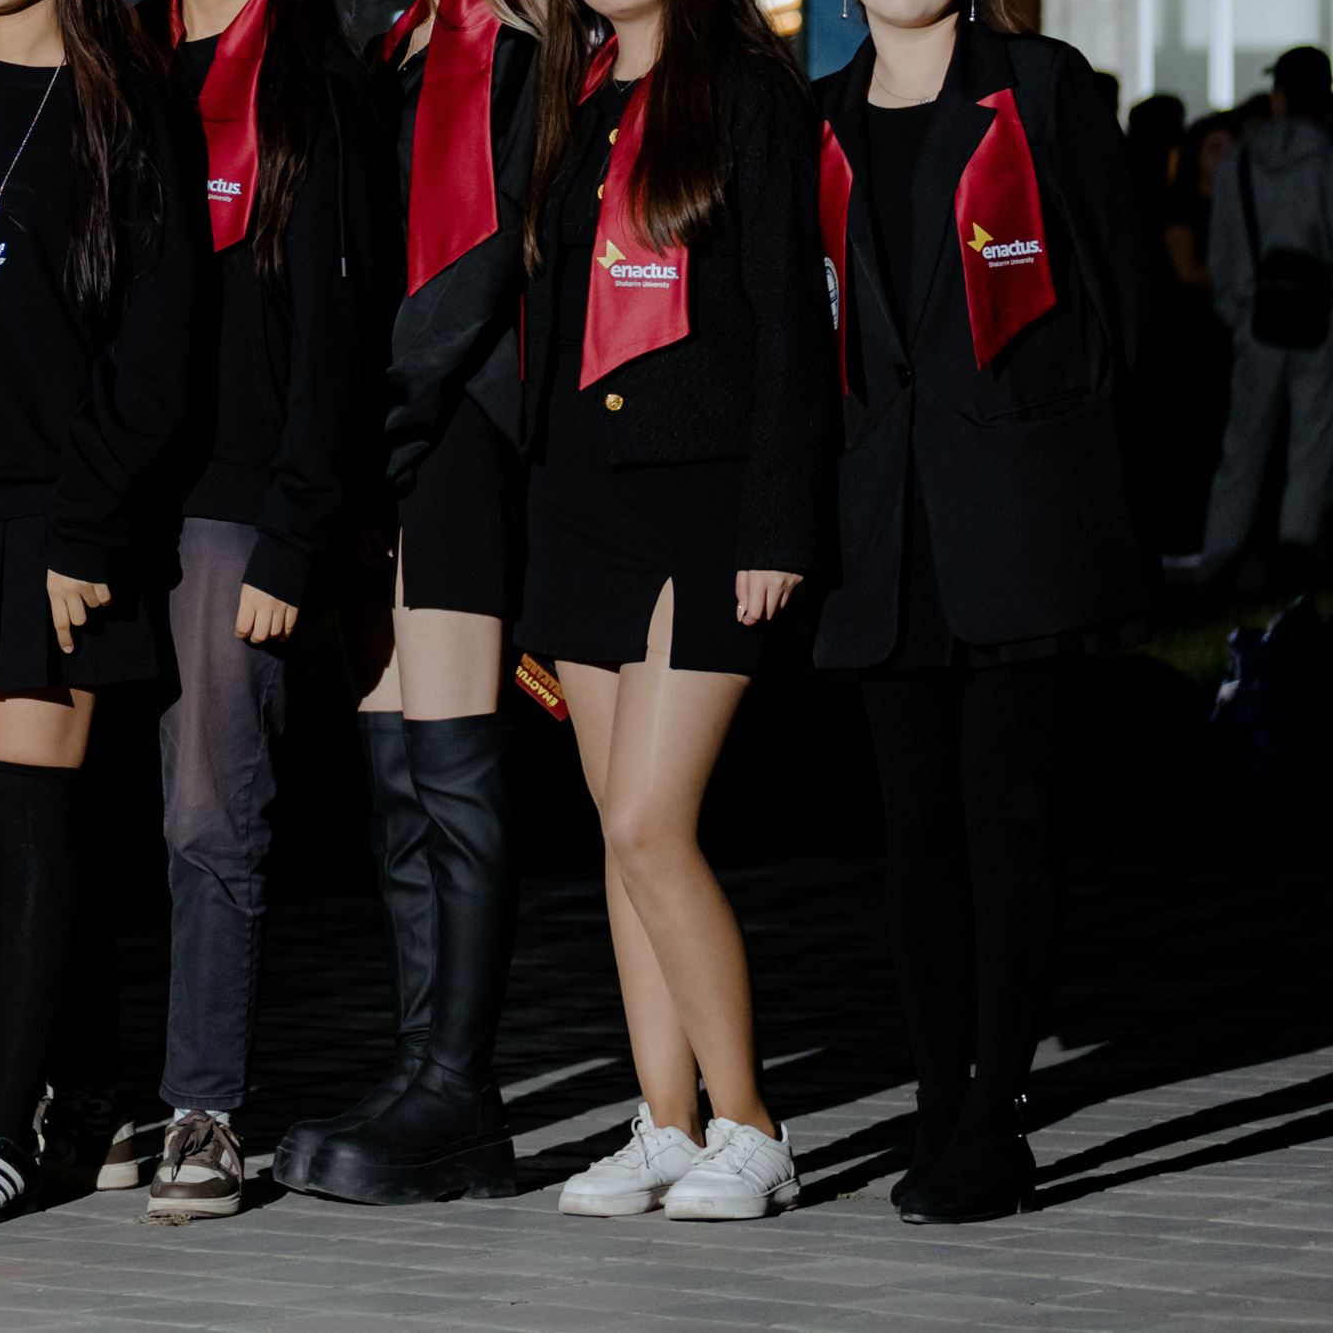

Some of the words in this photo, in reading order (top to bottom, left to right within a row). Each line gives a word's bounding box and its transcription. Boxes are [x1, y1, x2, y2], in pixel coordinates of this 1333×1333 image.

[207, 178, 242, 195] ctus.
[982, 240, 1043, 259] enactus.
[610, 263, 679, 279] enactus.
